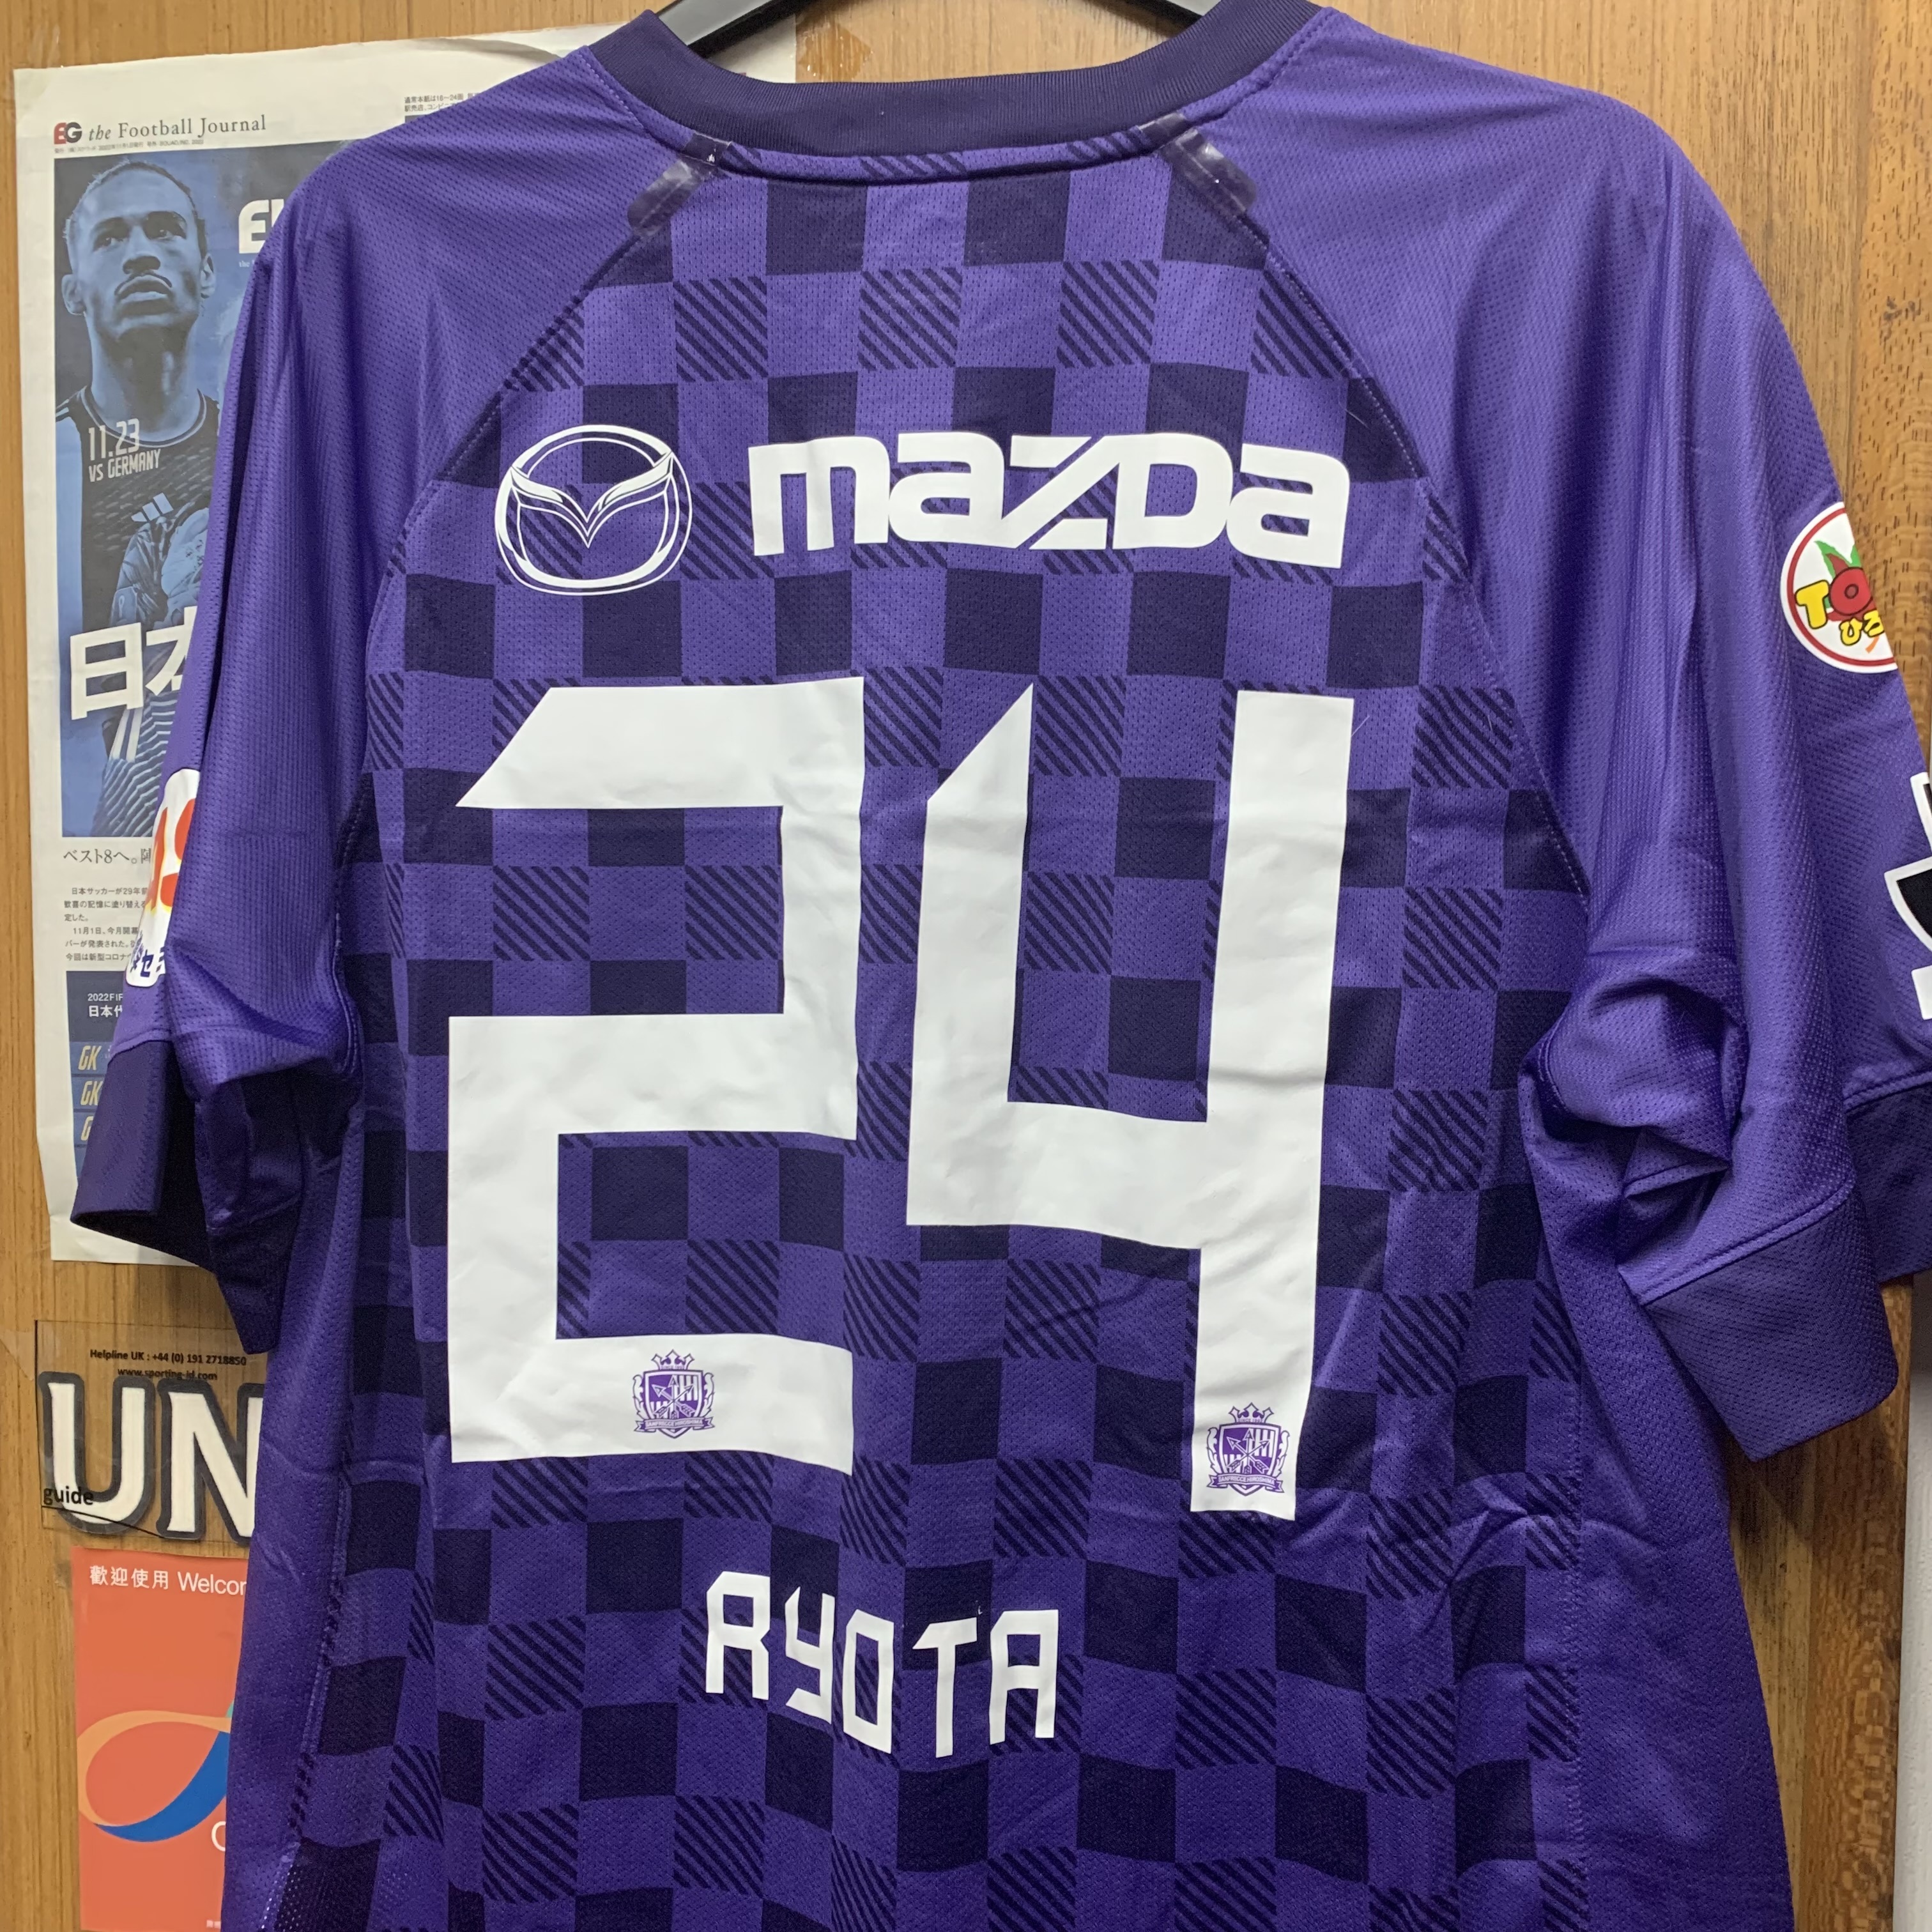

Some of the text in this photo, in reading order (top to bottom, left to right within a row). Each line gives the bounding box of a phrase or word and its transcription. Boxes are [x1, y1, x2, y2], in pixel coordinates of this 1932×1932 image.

[54, 114, 266, 144] EG the Football Journal
[88, 418, 140, 461] 11.23
[88, 448, 161, 482] VS GERMANY
[78, 1045, 102, 1071] GK
[80, 1081, 103, 1106] GK
[448, 677, 1354, 1520] 24
[90, 1349, 128, 1361] Helpline
[131, 1351, 144, 1361] UK
[152, 1353, 169, 1362] +44
[171, 1353, 184, 1364] (0)
[187, 1354, 203, 1363] 191
[43, 1486, 95, 1505] guide
[89, 1565, 169, 1590] 歡迎使用
[706, 1571, 1059, 1758] RYOTA
